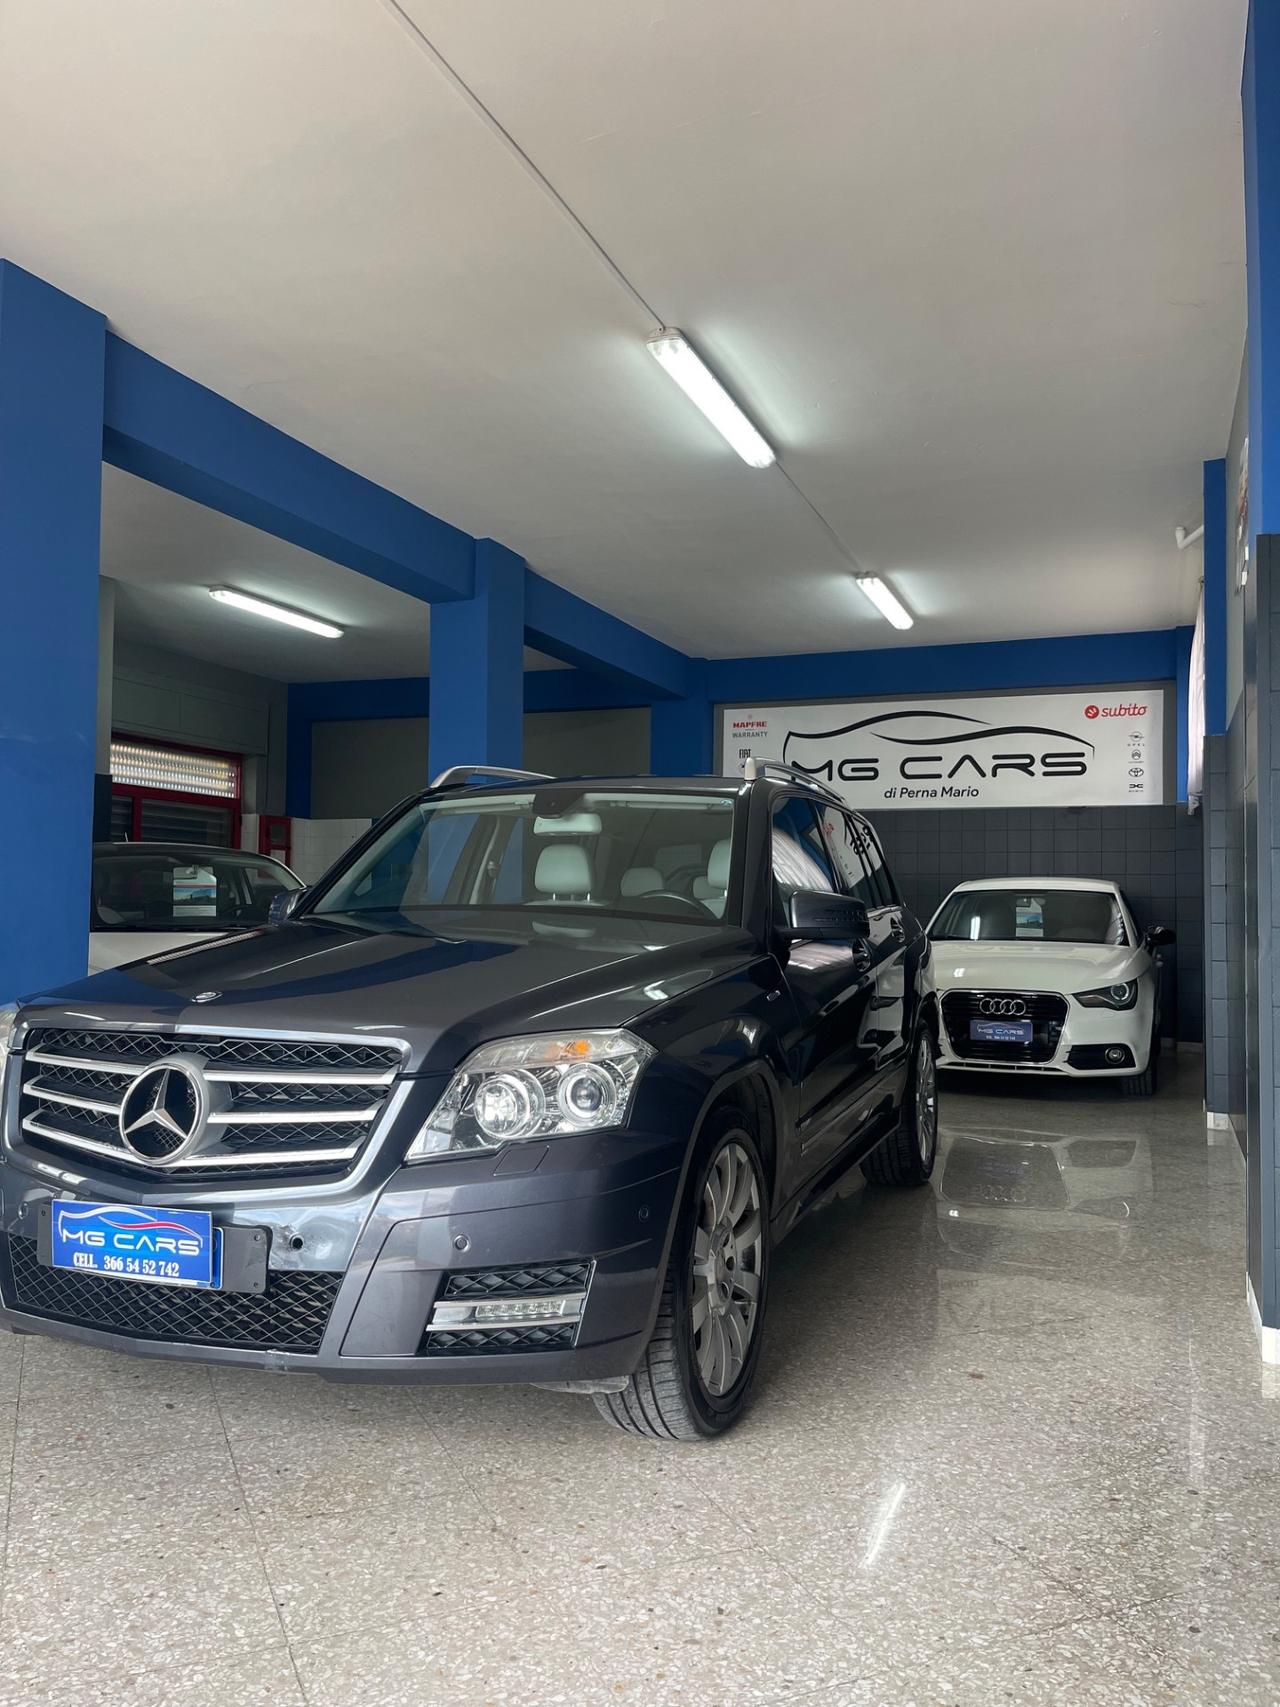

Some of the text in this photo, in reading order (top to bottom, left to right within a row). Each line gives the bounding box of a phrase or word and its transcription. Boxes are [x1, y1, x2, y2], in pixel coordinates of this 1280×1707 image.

[1101, 703, 1148, 718] subito
[732, 721, 768, 729] MAPFRE
[791, 752, 1088, 782] MG CARS
[884, 785, 979, 799] di Perna Mario
[62, 1228, 200, 1256] MG CARS
[73, 1252, 180, 1278] CELL. 366 54 52 742
